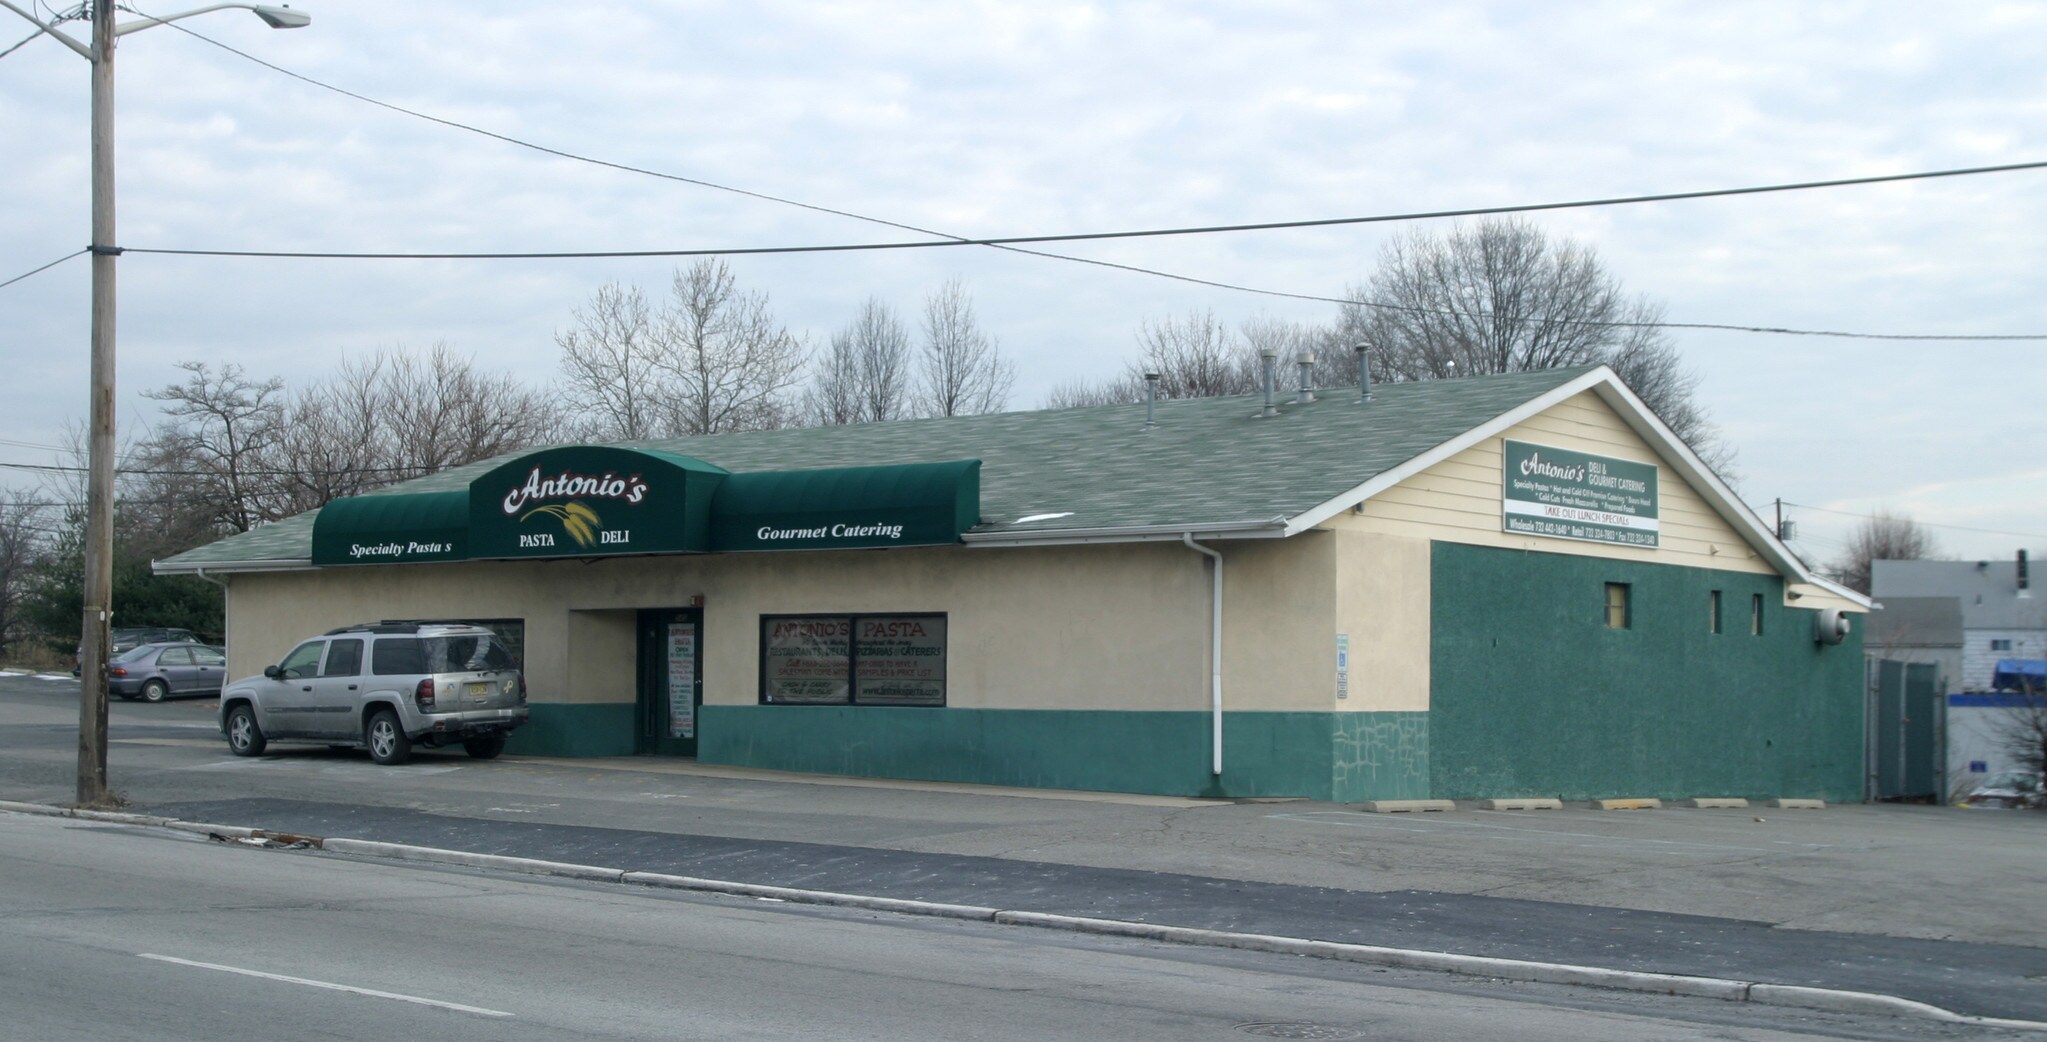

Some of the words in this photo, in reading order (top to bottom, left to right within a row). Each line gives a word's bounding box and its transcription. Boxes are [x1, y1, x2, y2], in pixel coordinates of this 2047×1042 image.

[1520, 452, 1585, 482] Antonio's
[1588, 462, 1601, 475] DELI
[1602, 464, 1607, 475] &
[503, 467, 648, 515] Antonio's
[1513, 479, 1534, 492] Specialty
[1562, 486, 1571, 495] and
[1588, 474, 1617, 489] GOURMET
[1618, 478, 1646, 493] CATERING
[1539, 492, 1549, 502] Cold
[1545, 505, 1560, 517] TAKE
[1562, 508, 1576, 519] OUT
[1578, 510, 1600, 522] LUNCH
[757, 525, 827, 540] Gourmet
[831, 522, 903, 539] Catering
[1509, 518, 1534, 531] Wholesale
[519, 534, 555, 548] PASTA
[600, 530, 630, 544] DELI
[349, 542, 404, 558] Specialty
[407, 541, 442, 554] Pasta
[773, 622, 849, 638] ANTONIO'S
[864, 622, 926, 637] PASTA
